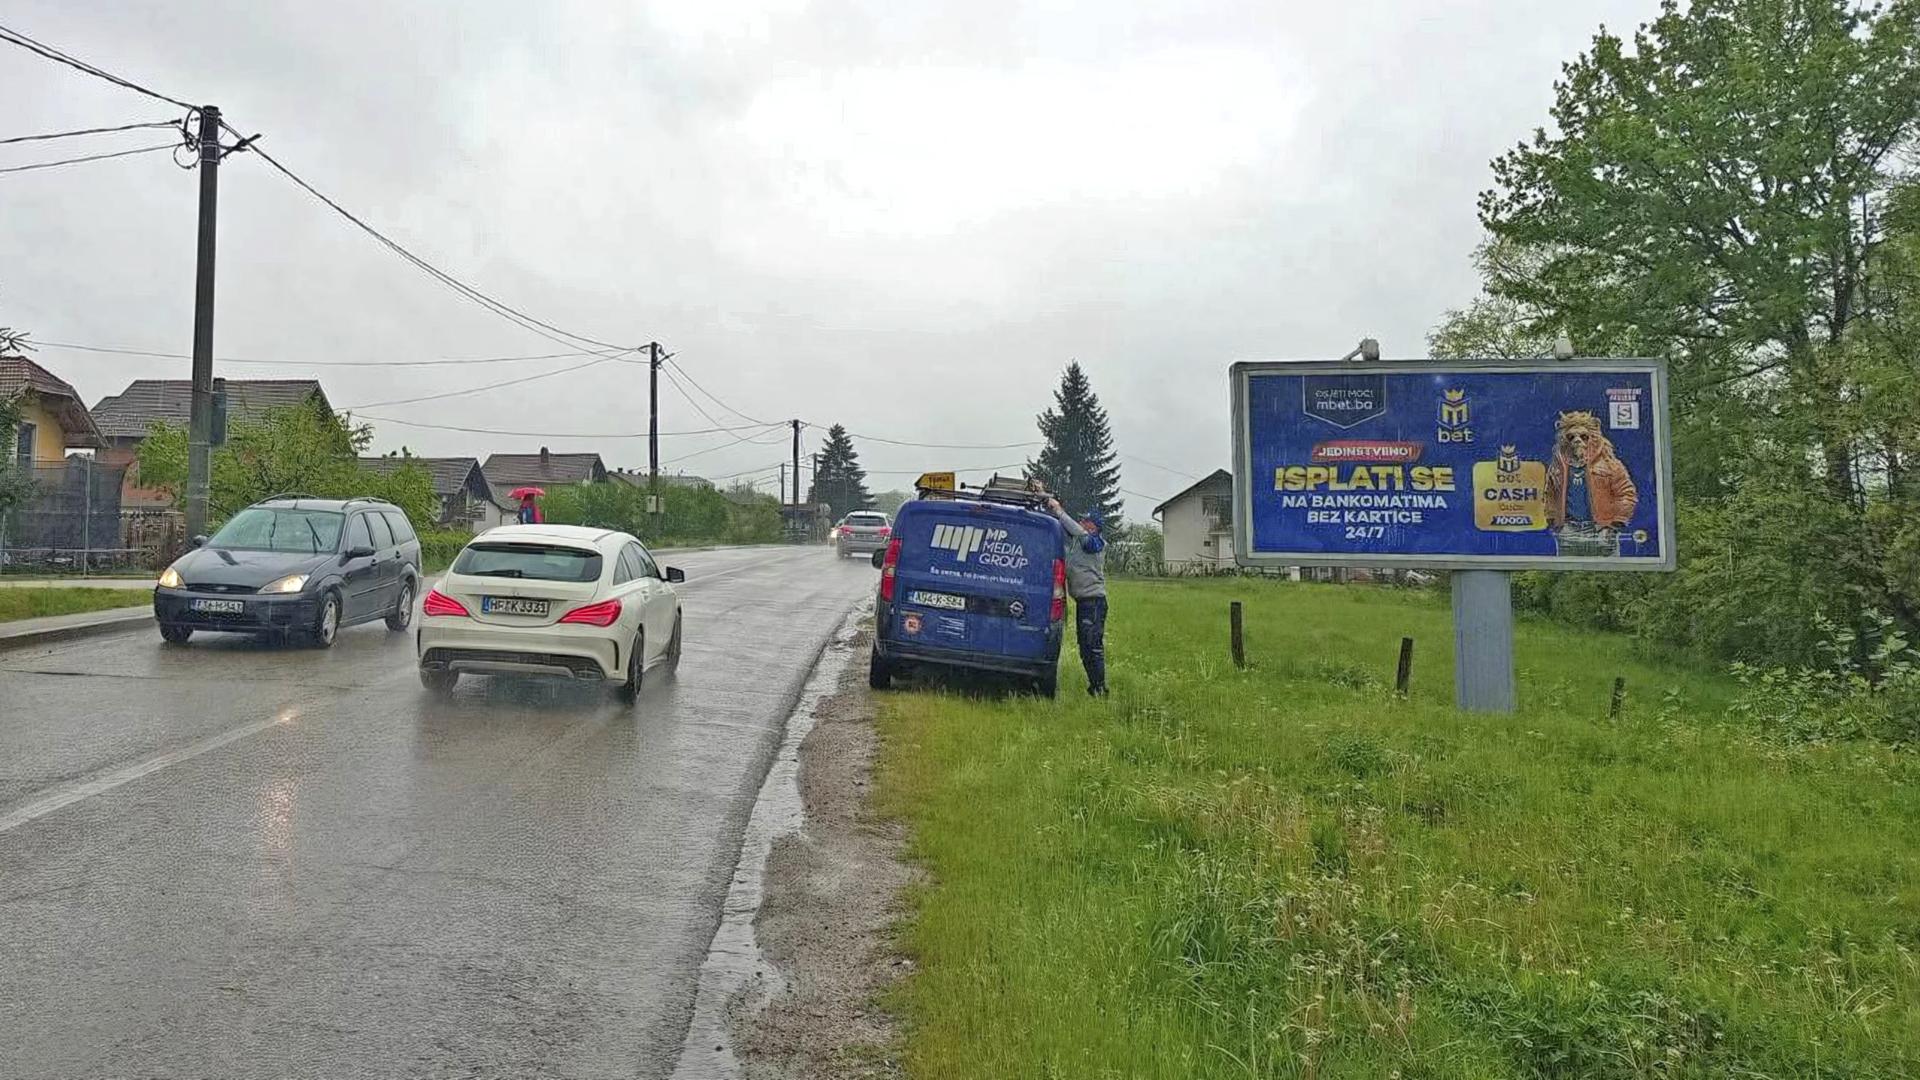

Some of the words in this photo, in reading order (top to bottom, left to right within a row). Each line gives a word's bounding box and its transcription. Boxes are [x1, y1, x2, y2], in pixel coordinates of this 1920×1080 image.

[1316, 398, 1373, 410] mbet.ba
[1437, 427, 1475, 443] bet
[1274, 466, 1404, 492] ISPLATI
[1410, 466, 1456, 492] SE
[1484, 487, 1538, 501] CASH
[1282, 495, 1308, 508] NA
[1311, 495, 1448, 509] BANKOMATIMA
[1307, 511, 1341, 523] BEZ
[1344, 511, 1423, 523] KARTICE
[985, 528, 1008, 541] MP
[1345, 526, 1385, 539] 24/7
[982, 541, 1024, 556] MEDIA
[979, 554, 1029, 569] GROUP
